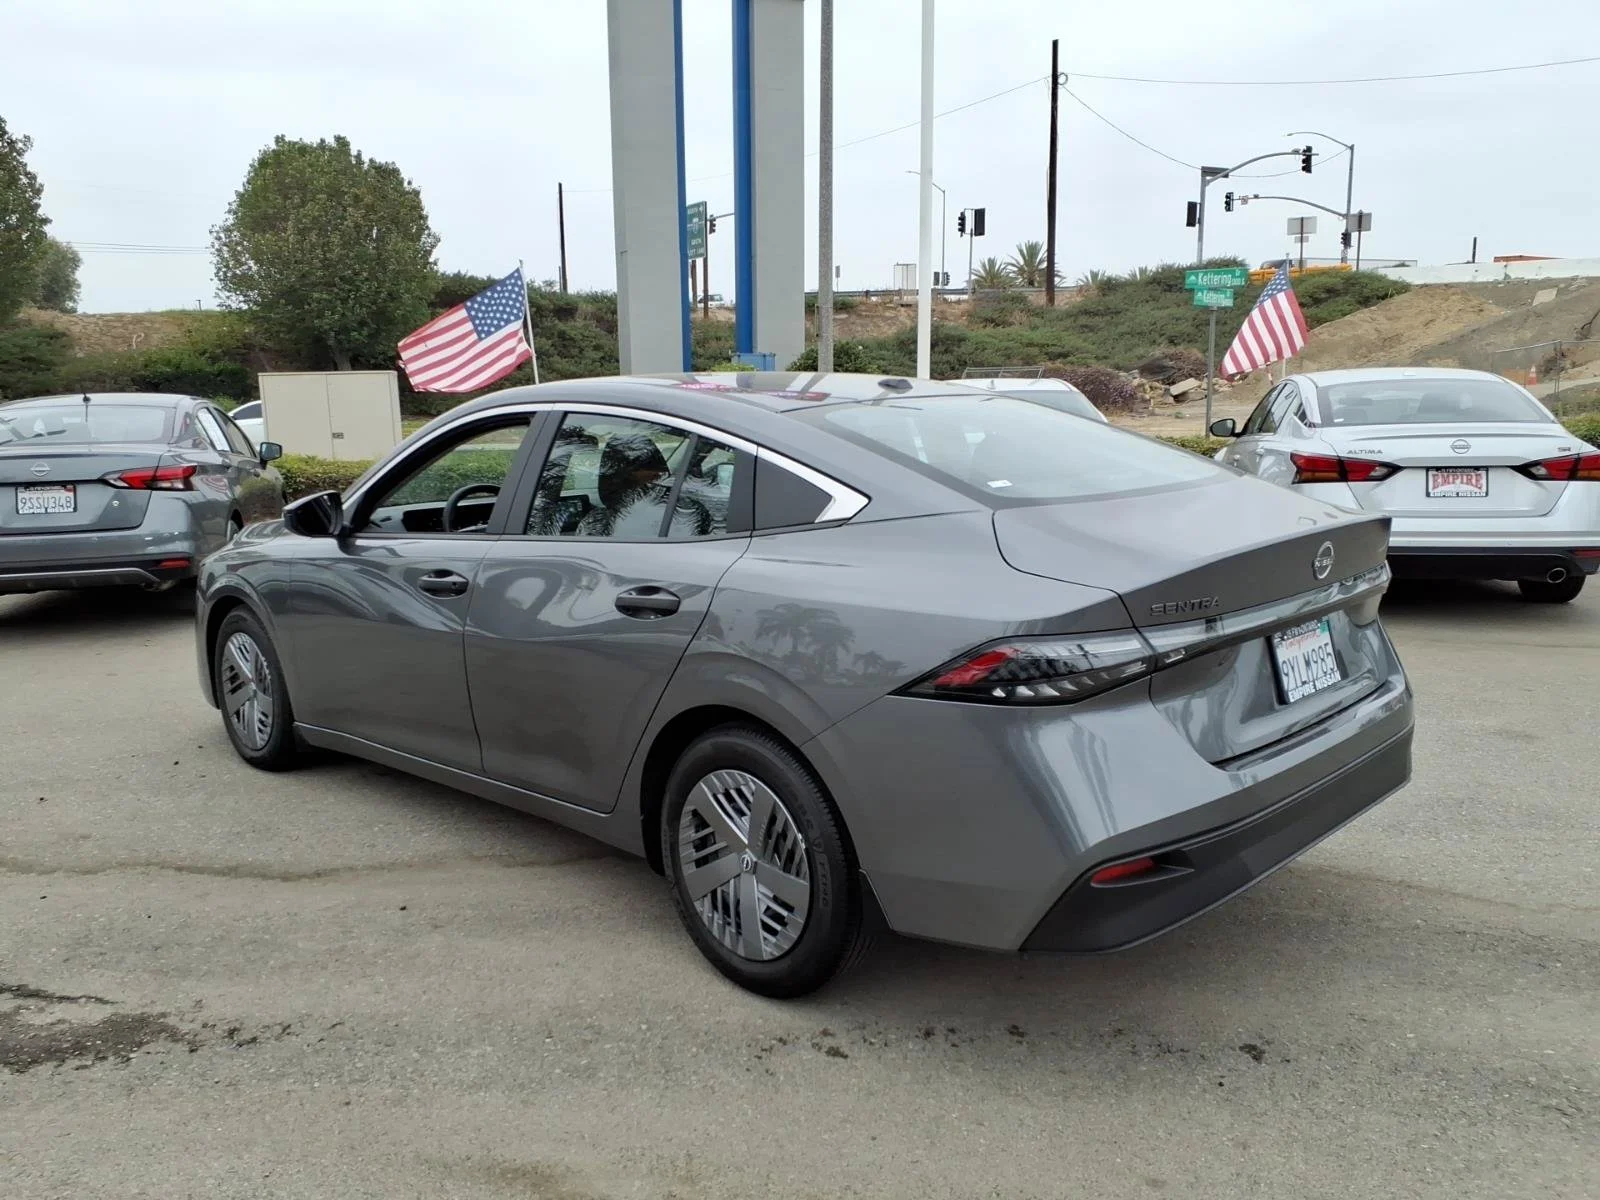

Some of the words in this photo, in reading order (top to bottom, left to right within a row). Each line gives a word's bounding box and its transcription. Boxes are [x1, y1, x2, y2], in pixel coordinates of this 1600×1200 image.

[1198, 272, 1232, 287] Kettering
[1431, 473, 1483, 490] EMPIRE
[1150, 597, 1219, 616] SENTRA
[1281, 643, 1336, 692] 9YLM985
[1288, 681, 1316, 702] EMPIRE
[1315, 670, 1341, 691] NISSAN
